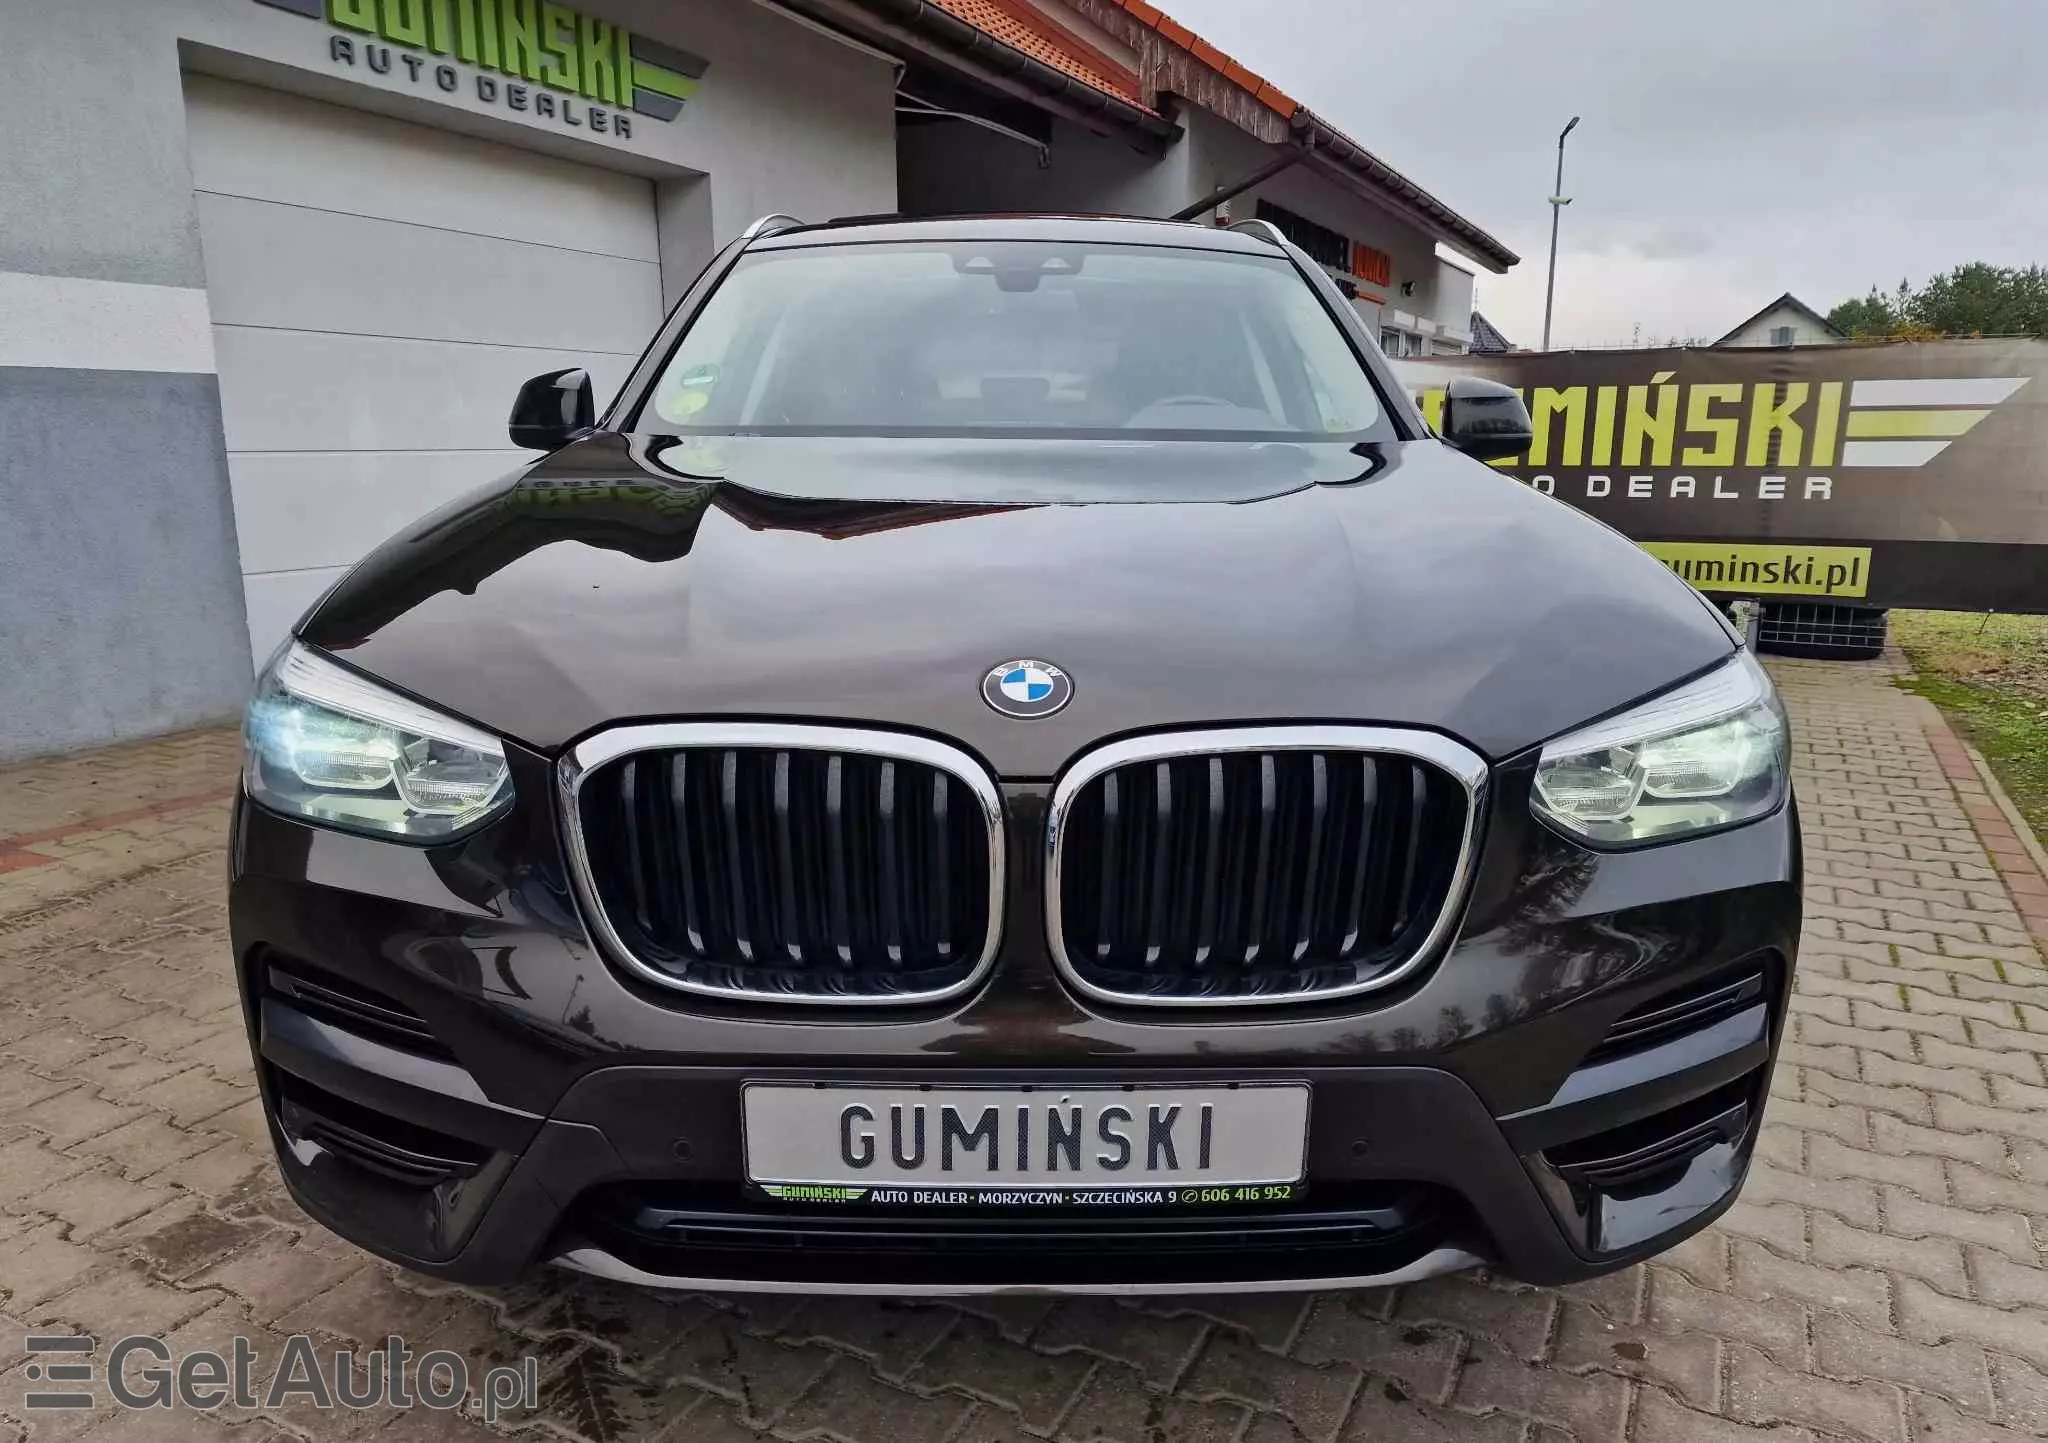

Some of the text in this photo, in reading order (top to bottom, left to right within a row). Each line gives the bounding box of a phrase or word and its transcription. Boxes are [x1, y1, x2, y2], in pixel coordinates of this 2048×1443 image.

[330, 34, 633, 139] AUTO DEALER
[1422, 370, 1844, 468] MIŃSKI
[1586, 475, 1833, 500] DEALER
[1660, 554, 1860, 594] uminski.pl
[993, 660, 1062, 677] BMW
[839, 1095, 1215, 1172] GUMIŃSKI
[871, 1185, 1292, 1205] AUTO DEALER MORZYCZYN SZCZECIŃSKA 9 606 416 952
